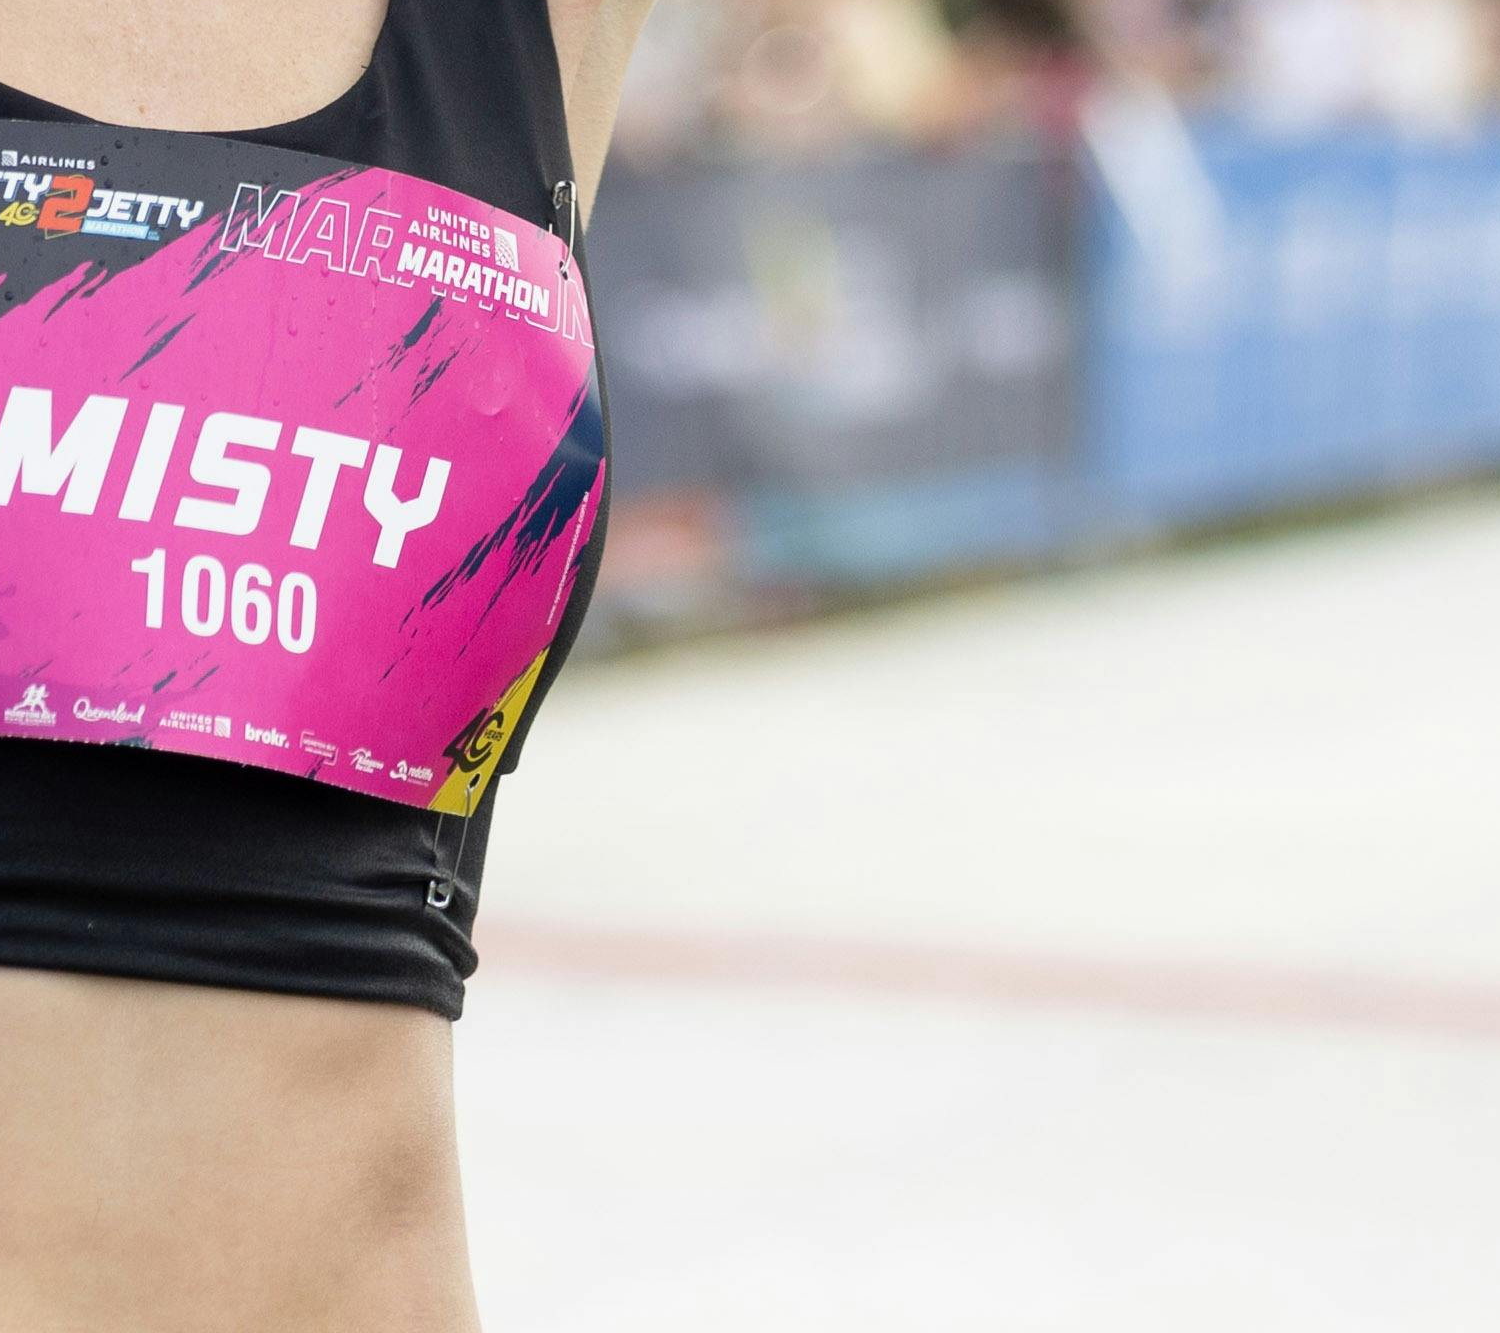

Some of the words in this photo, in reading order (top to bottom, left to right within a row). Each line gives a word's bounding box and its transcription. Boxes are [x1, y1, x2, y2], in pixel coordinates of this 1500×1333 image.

[19, 155, 96, 171] AIRLINES
[86, 189, 205, 232] JETTY
[427, 206, 491, 240] UNITED
[408, 221, 491, 259] AIRLINES
[397, 244, 550, 318] MARATHON
[131, 548, 319, 655] 1060
[72, 698, 145, 725] Queensland
[159, 717, 213, 734] AIRLINES
[170, 710, 213, 725] UNITED
